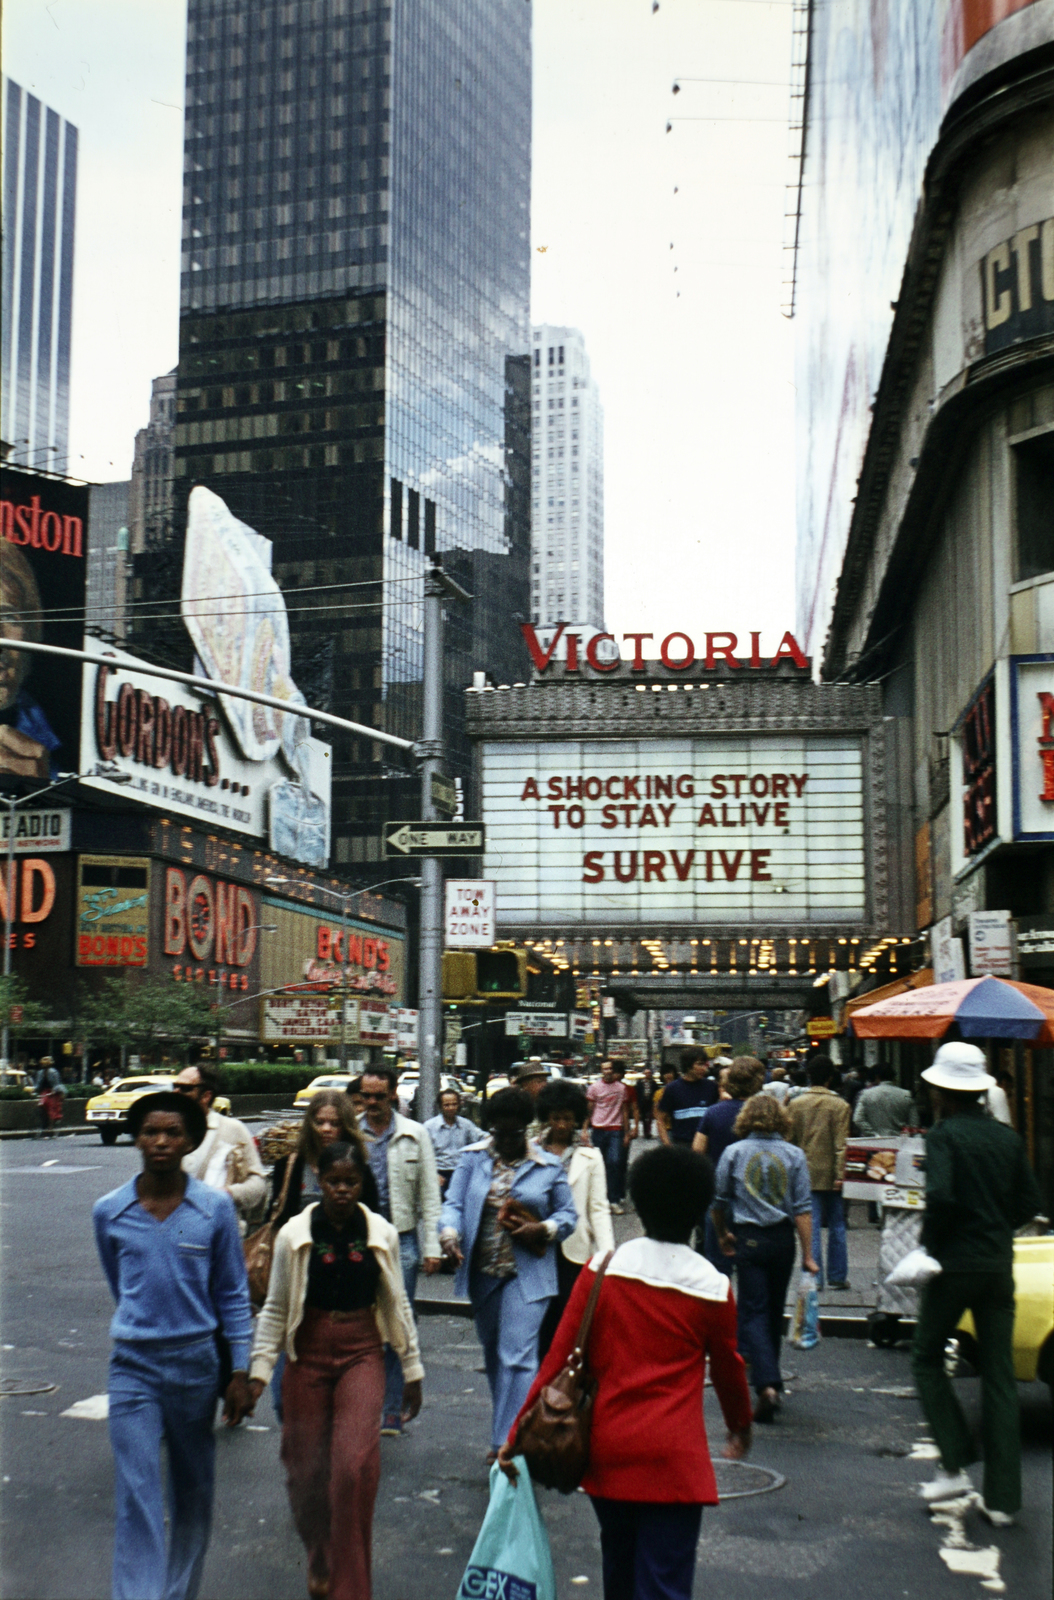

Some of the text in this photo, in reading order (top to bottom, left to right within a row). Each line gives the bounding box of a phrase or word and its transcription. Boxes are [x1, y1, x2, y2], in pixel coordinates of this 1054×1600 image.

[0, 494, 83, 557] nston
[521, 622, 809, 674] VICTORIA
[521, 773, 809, 801] A SHOCKING STORY
[548, 802, 790, 829] TO STAY ALIVE
[399, 831, 477, 845] ONE WAY
[582, 849, 773, 883] SURVIVE
[457, 889, 486, 900] TOW
[164, 867, 257, 967] BOND
[450, 906, 491, 918] AWAY
[450, 923, 489, 935] ZONE
[78, 935, 148, 957] BOND'S
[464, 1569, 508, 1600] GEX
